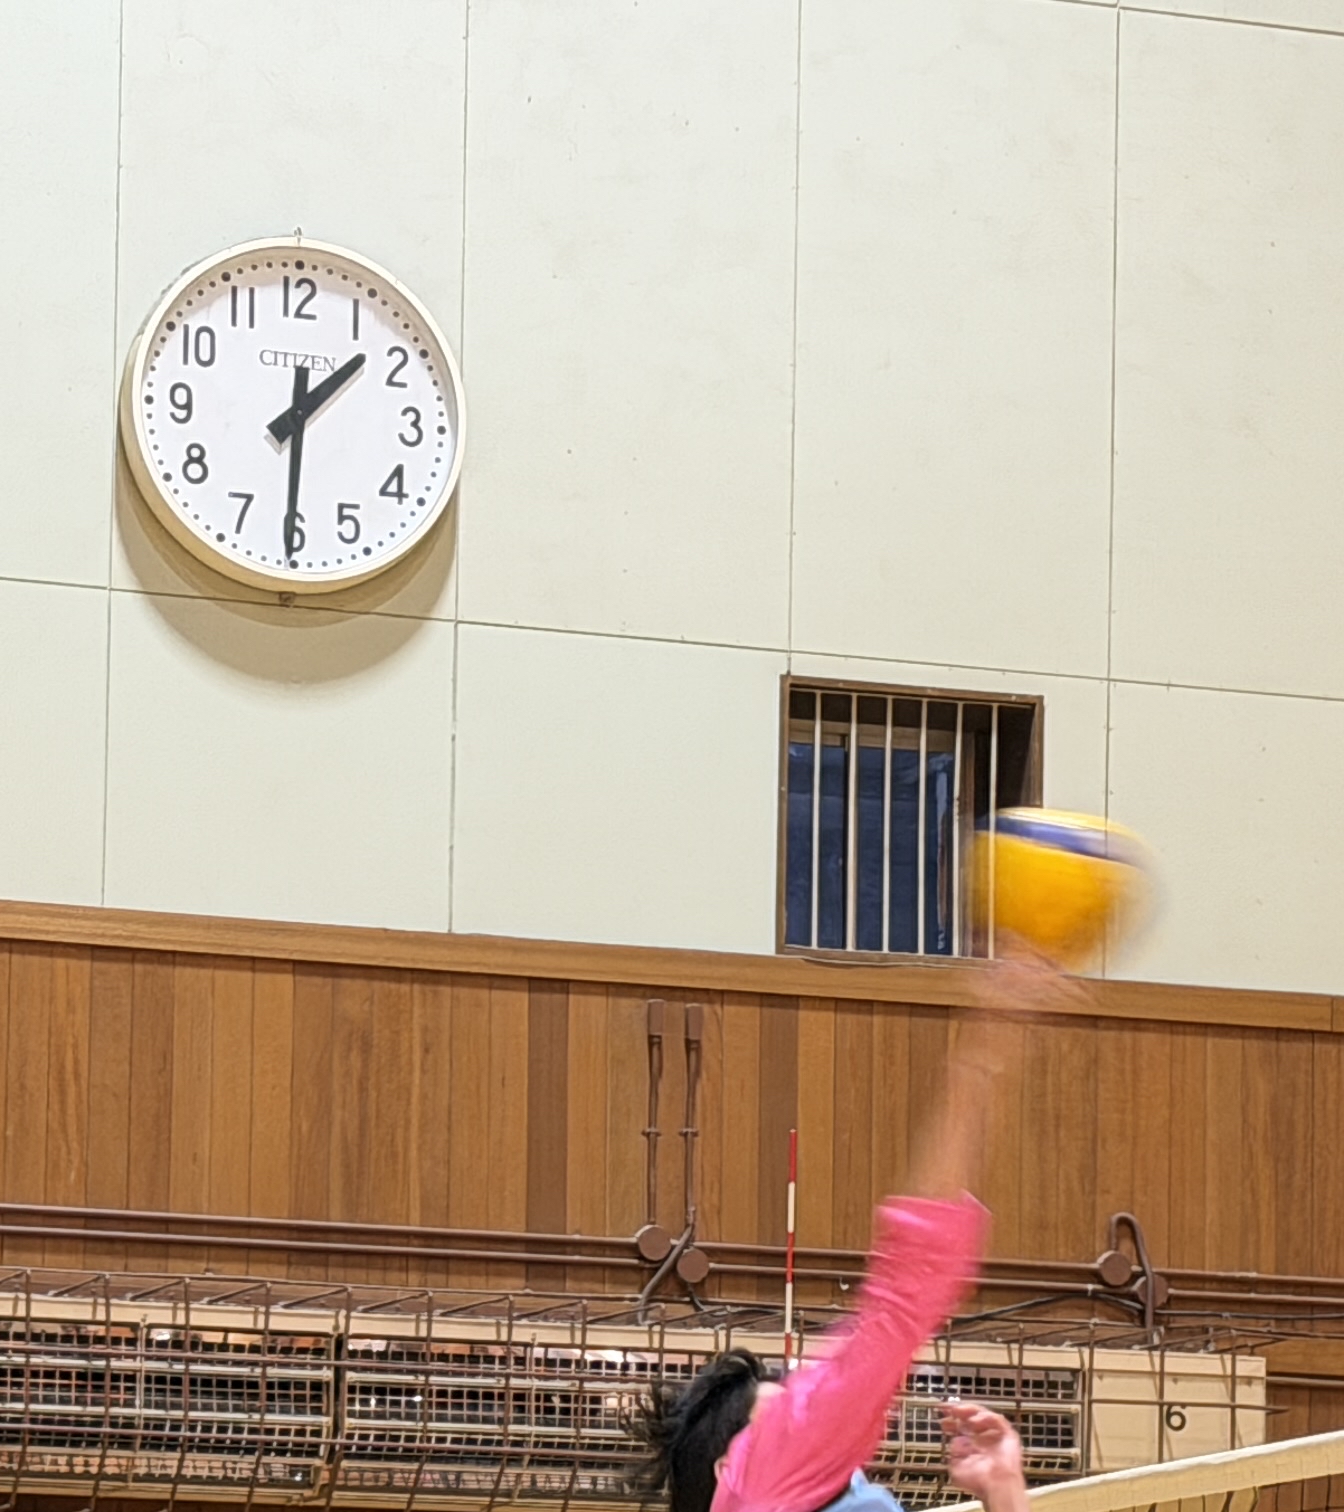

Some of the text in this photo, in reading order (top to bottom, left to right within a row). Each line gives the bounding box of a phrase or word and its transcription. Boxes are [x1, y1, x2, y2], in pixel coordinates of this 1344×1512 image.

[230, 284, 256, 329] 11
[282, 275, 318, 321] 12
[352, 297, 360, 341] 1
[181, 323, 217, 368] 10
[258, 349, 337, 373] CITIZEN
[384, 345, 409, 388] 2
[168, 381, 193, 425] 9
[397, 405, 424, 448] 3
[181, 442, 209, 485] 8
[378, 463, 410, 505] 4
[227, 491, 255, 534] 7
[283, 510, 306, 553] 6
[336, 502, 361, 545] 5
[1164, 1402, 1187, 1432] 6
